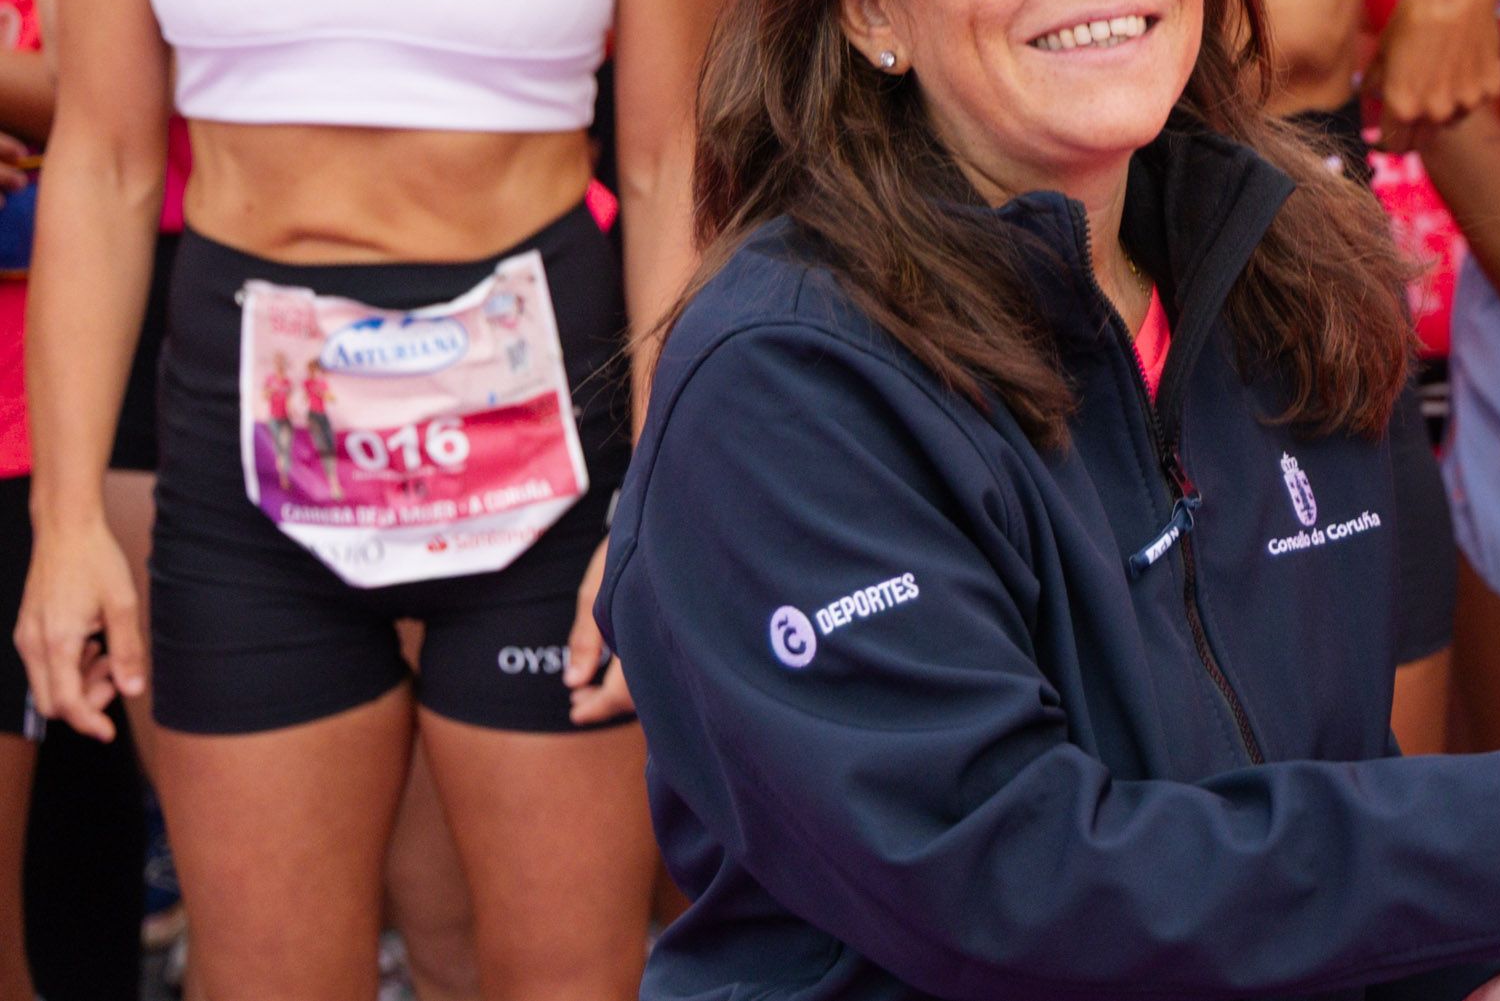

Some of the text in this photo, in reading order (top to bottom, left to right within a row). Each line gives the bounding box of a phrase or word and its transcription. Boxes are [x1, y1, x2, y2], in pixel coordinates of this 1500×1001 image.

[346, 418, 469, 474] 016
[1326, 510, 1381, 541] Coruña
[816, 572, 919, 635] DEPORTES
